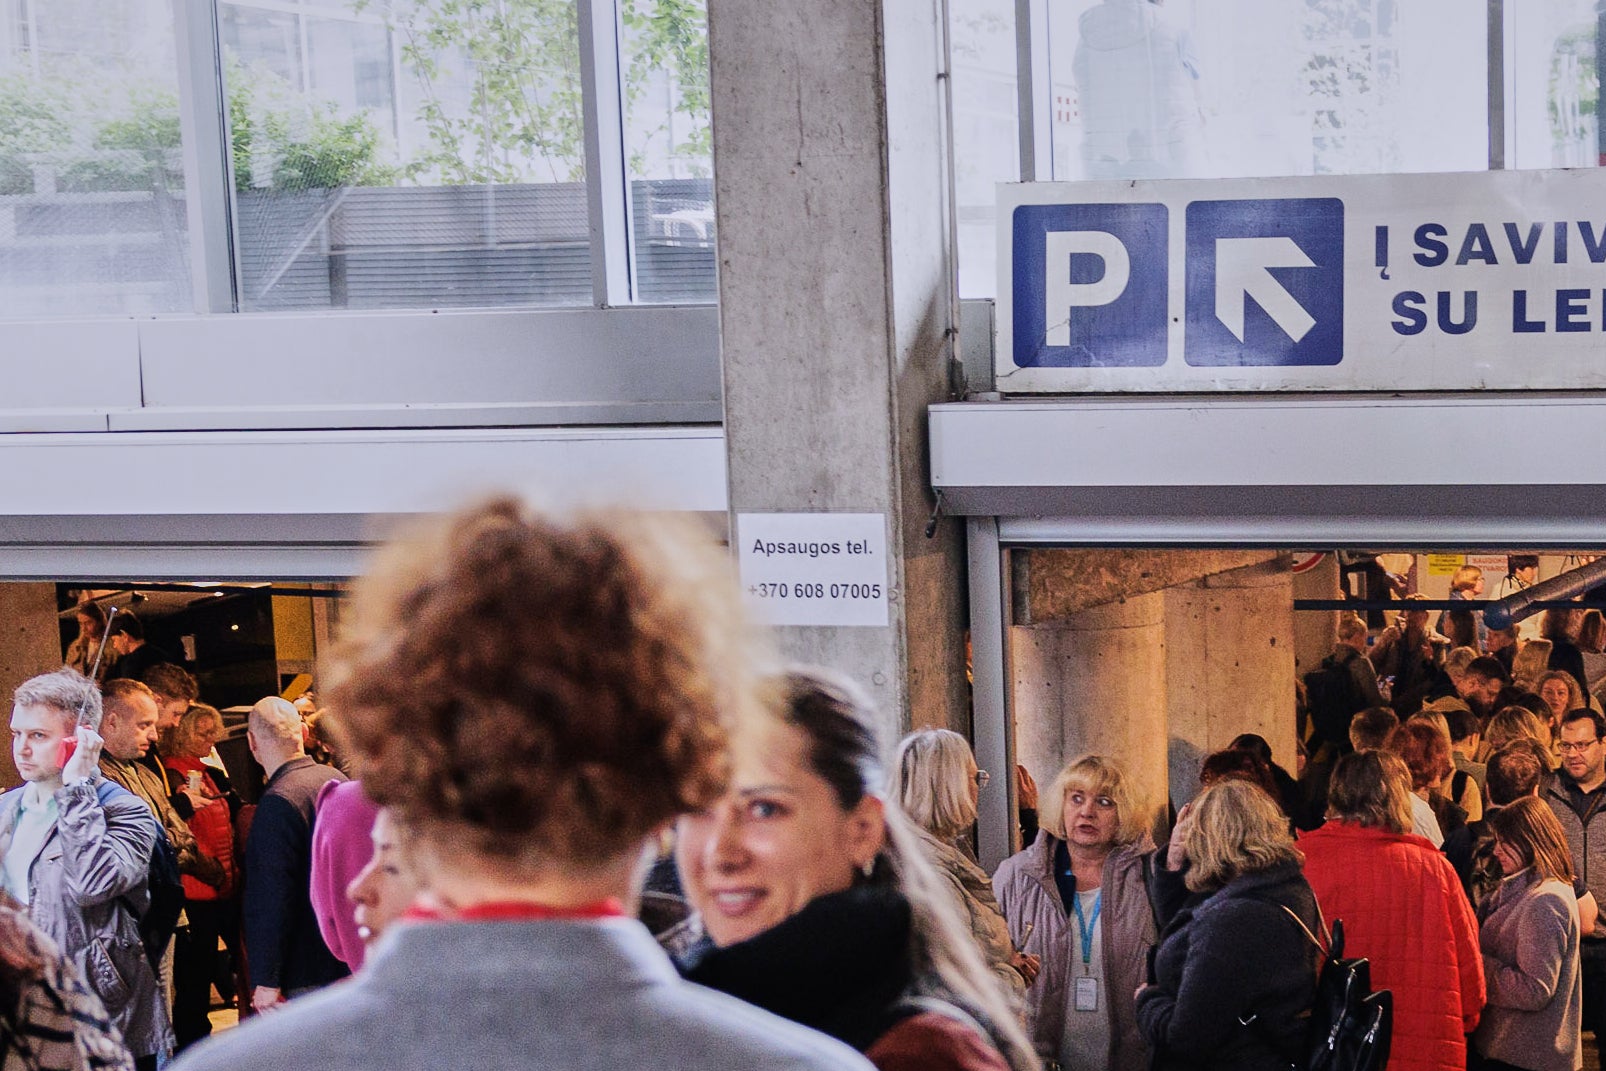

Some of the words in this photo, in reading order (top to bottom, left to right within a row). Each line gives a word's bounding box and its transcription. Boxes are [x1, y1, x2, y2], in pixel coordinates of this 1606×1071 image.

[1375, 225, 1391, 281] Į
[1045, 230, 1131, 348] P
[1390, 290, 1478, 336] SU
[752, 538, 841, 558] Apsaugos
[846, 539, 873, 555] tel.
[794, 583, 825, 599] 608
[830, 583, 881, 599] 07005
